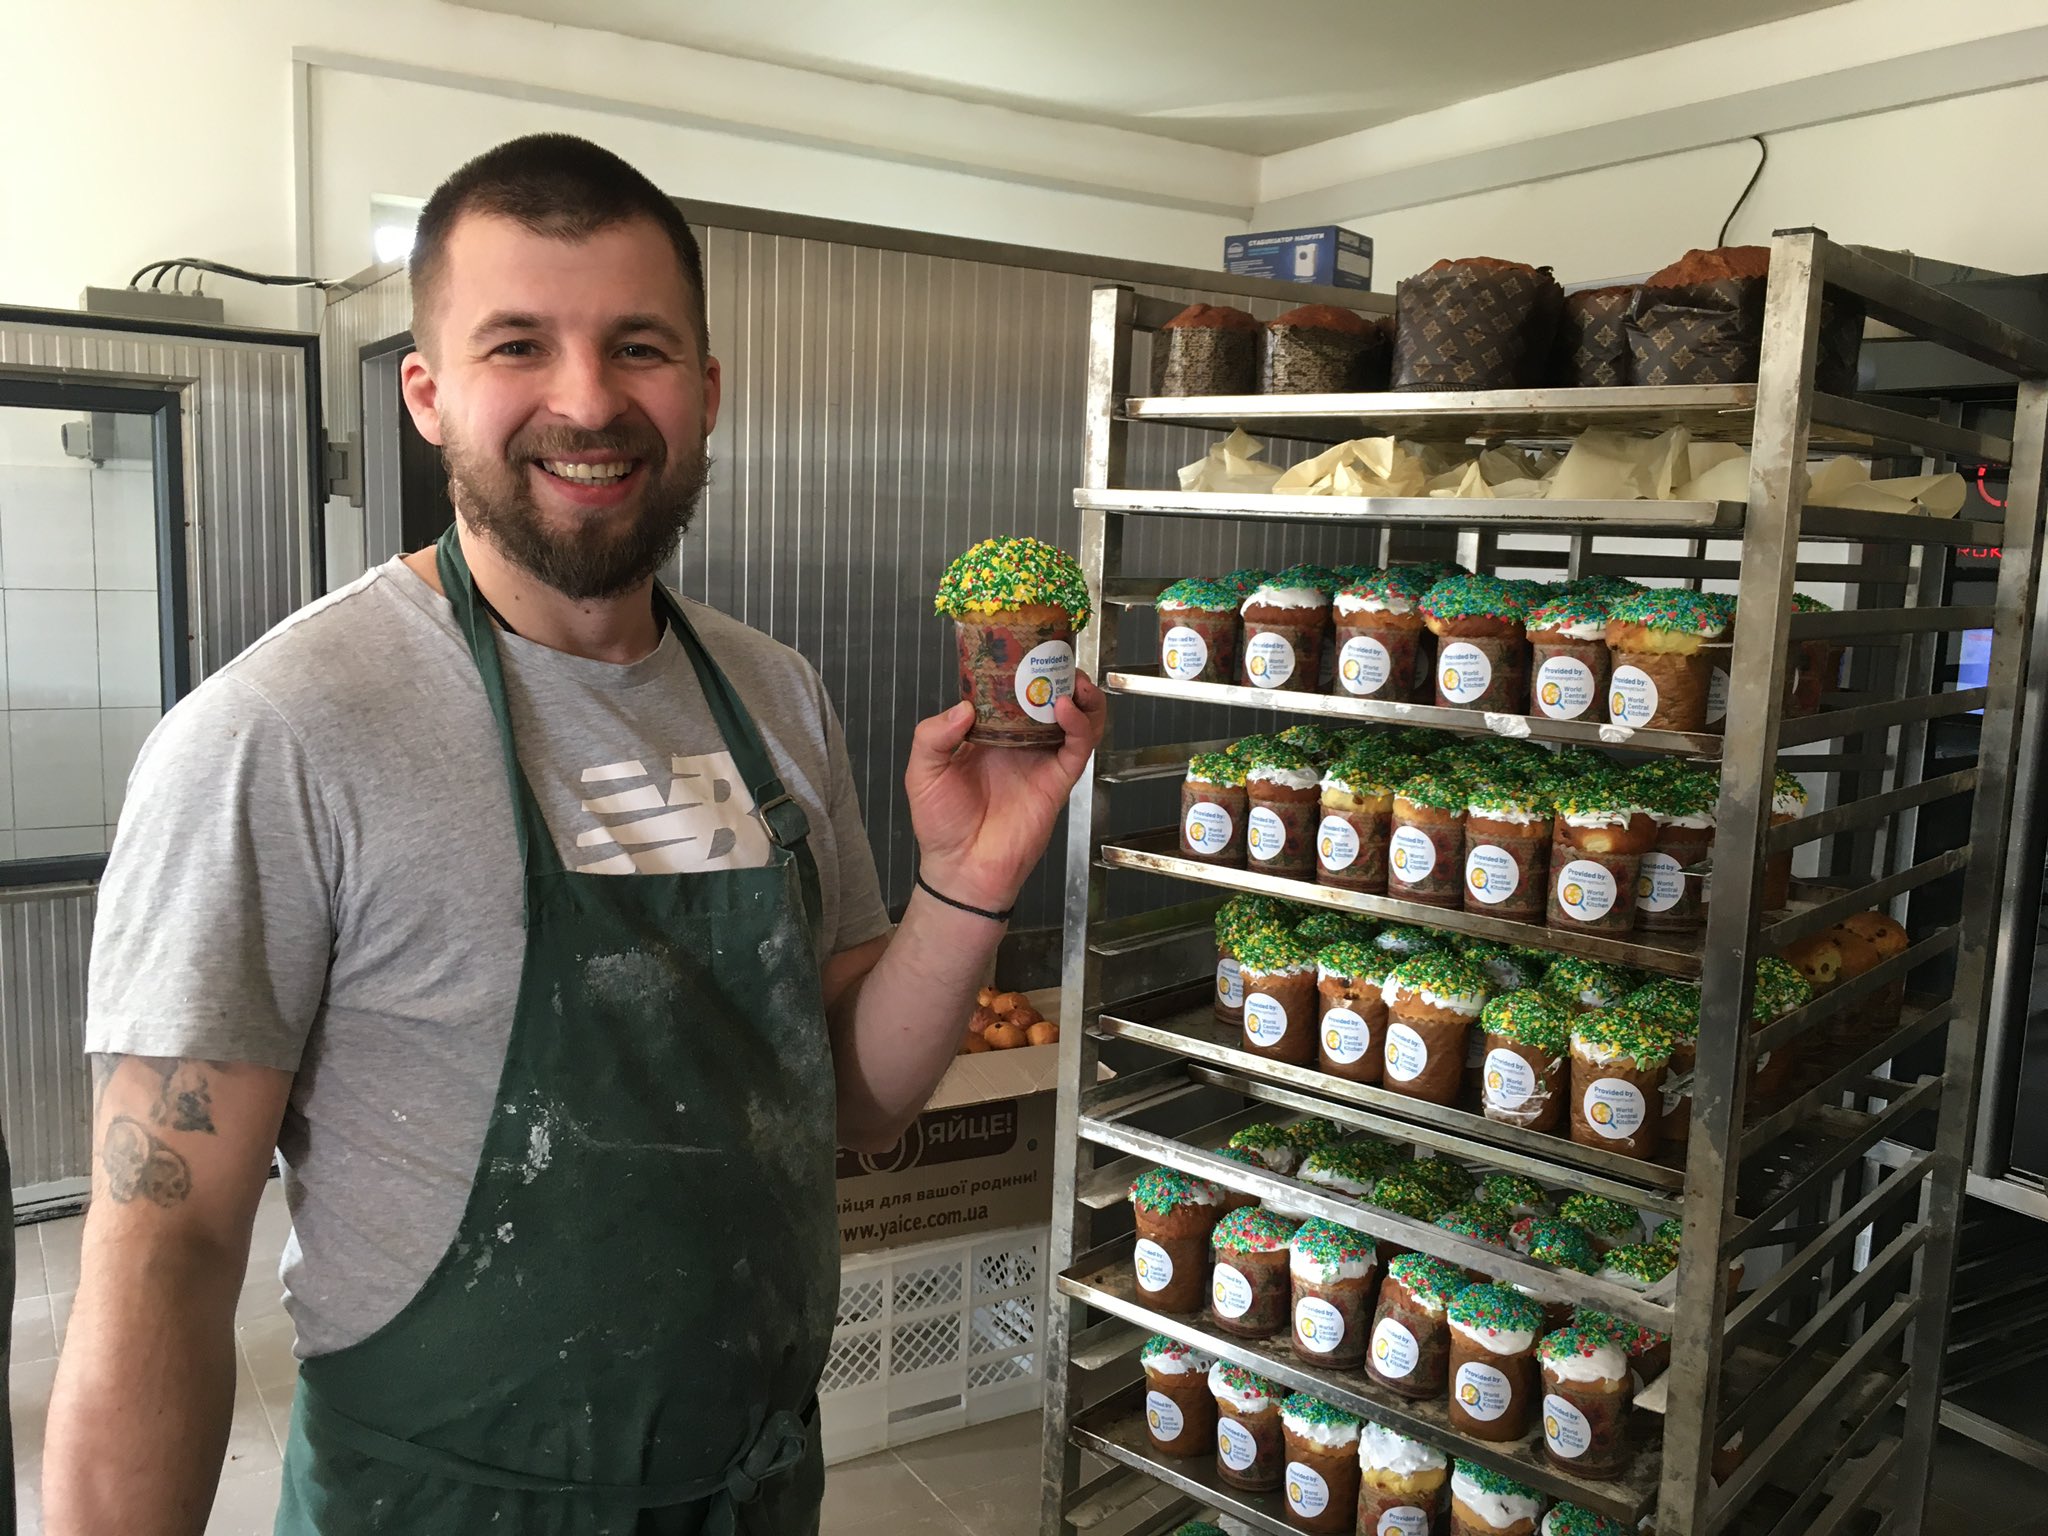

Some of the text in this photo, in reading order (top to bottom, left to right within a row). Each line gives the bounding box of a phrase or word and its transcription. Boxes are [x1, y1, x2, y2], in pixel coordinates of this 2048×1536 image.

[1031, 656, 1062, 665] Provided
[1614, 676, 1636, 684] Provided
[1474, 853, 1498, 863] Provided
[1568, 868, 1596, 879] Provided
[1491, 1055, 1515, 1068] Provided
[1594, 1086, 1624, 1096] Provided
[928, 1112, 1012, 1145] ЯЙЦЕ!
[880, 1192, 911, 1210] для
[917, 1180, 968, 1201] вашої
[971, 1170, 1037, 1195] родини!
[839, 1204, 988, 1242] ww.yaice.com.ua
[1464, 1368, 1492, 1382] Provided
